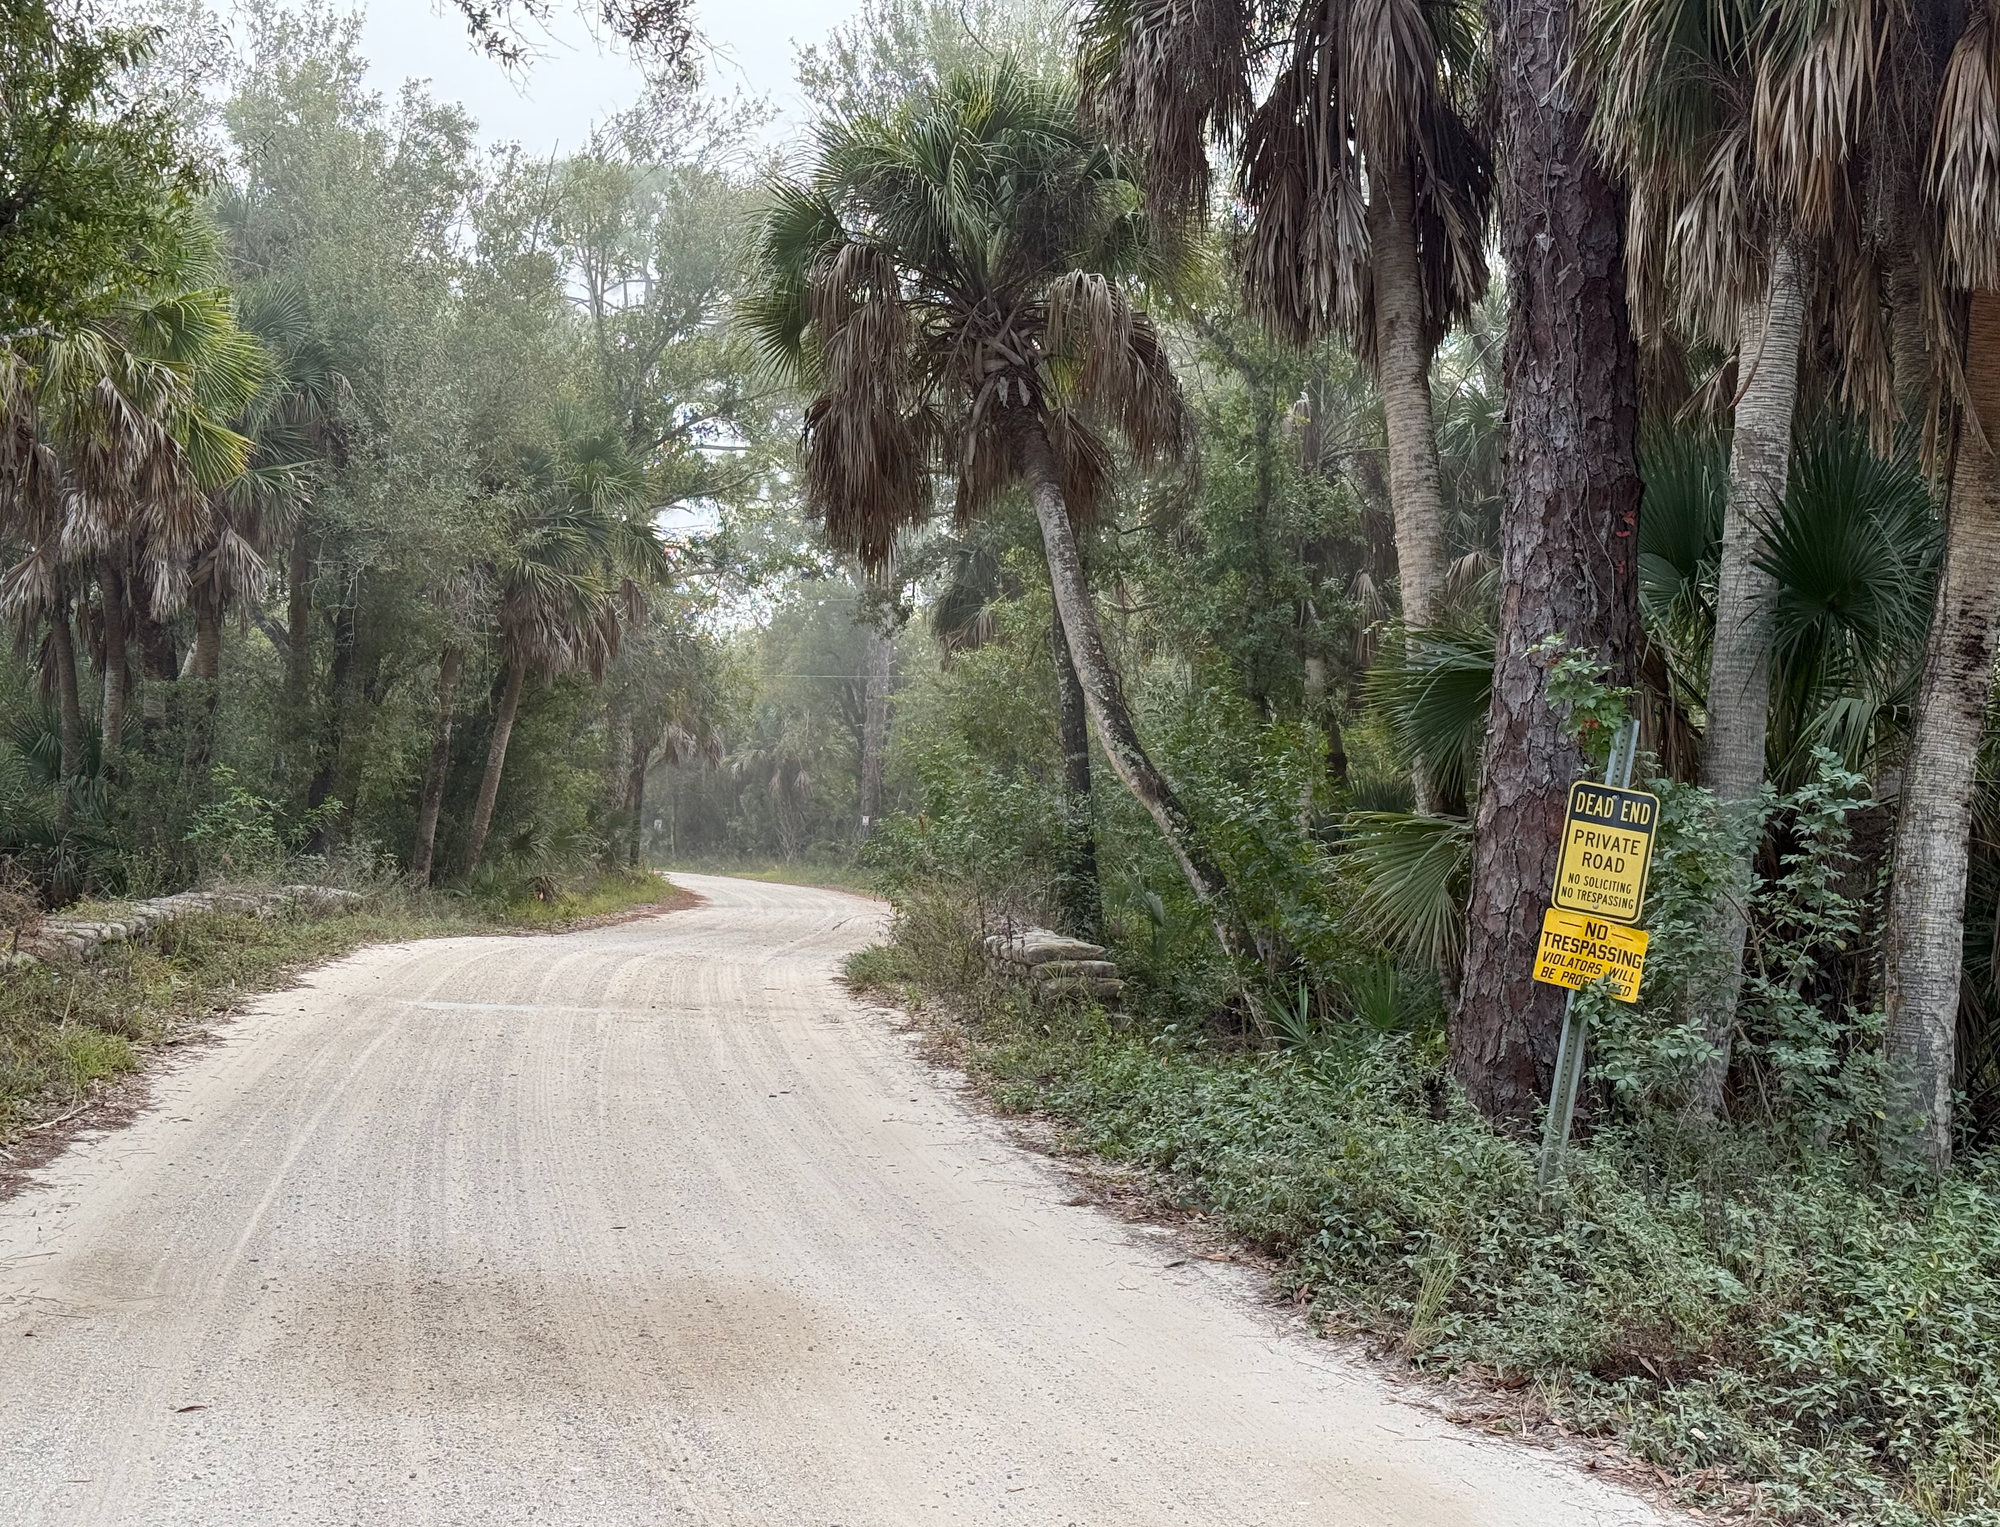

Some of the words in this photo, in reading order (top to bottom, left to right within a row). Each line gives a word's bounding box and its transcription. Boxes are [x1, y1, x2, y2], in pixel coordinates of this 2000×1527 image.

[1575, 792, 1614, 818] DEAD
[1621, 800, 1650, 825] END
[1574, 829, 1640, 856] PRIVATE
[1582, 852, 1625, 873] ROAD
[1568, 873, 1580, 884] NO
[1583, 875, 1632, 894] SOLICITING
[1561, 886, 1574, 898] NO
[1577, 889, 1634, 910] TRESPASSING
[1585, 922, 1608, 940] NO
[1544, 931, 1642, 969] TRESPASSING
[1543, 952, 1603, 975] VIOLATORS
[1609, 966, 1634, 983] WILL
[1541, 967, 1554, 979] BE
[1561, 971, 1631, 997] PROSEED
